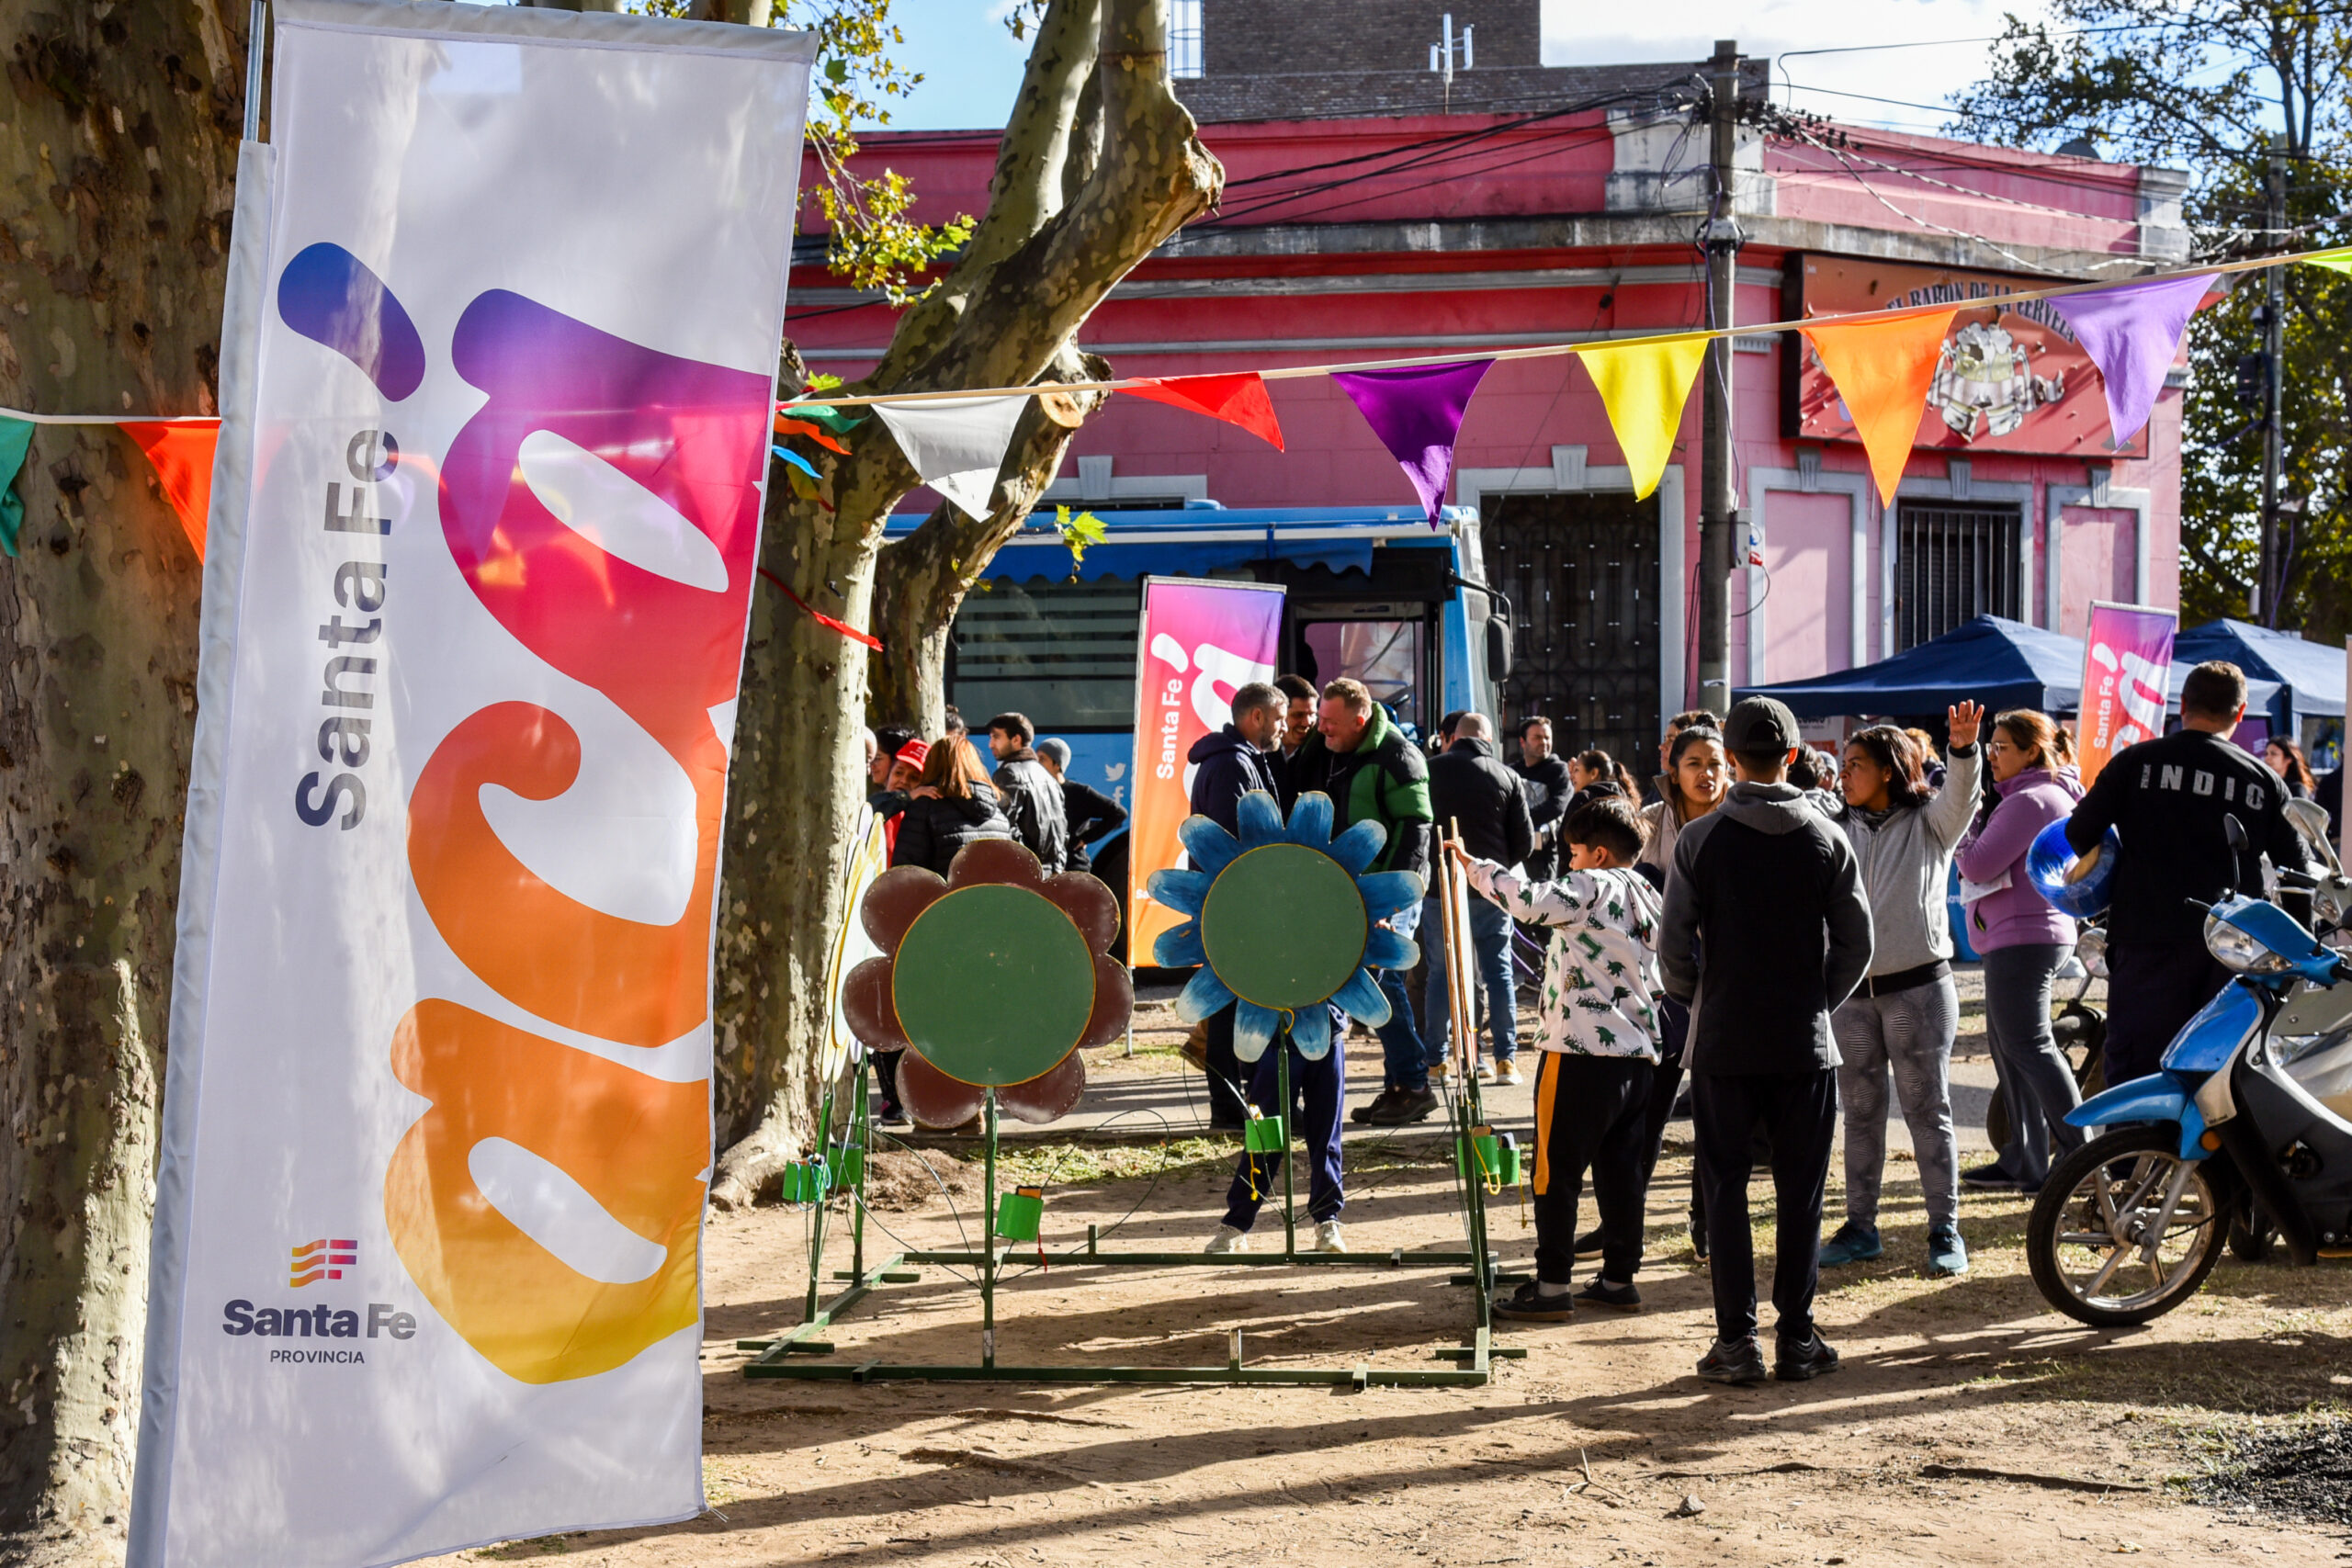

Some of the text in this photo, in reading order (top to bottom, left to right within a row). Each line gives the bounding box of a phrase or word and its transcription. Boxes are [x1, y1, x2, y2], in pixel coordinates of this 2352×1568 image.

[295, 429, 400, 831] Santa Fe
[1156, 679, 1182, 779] Santa Fe
[2093, 675, 2114, 749] Santa Fe
[222, 1299, 417, 1340] Santa Fe
[270, 1349, 366, 1364] PROVINCIA
